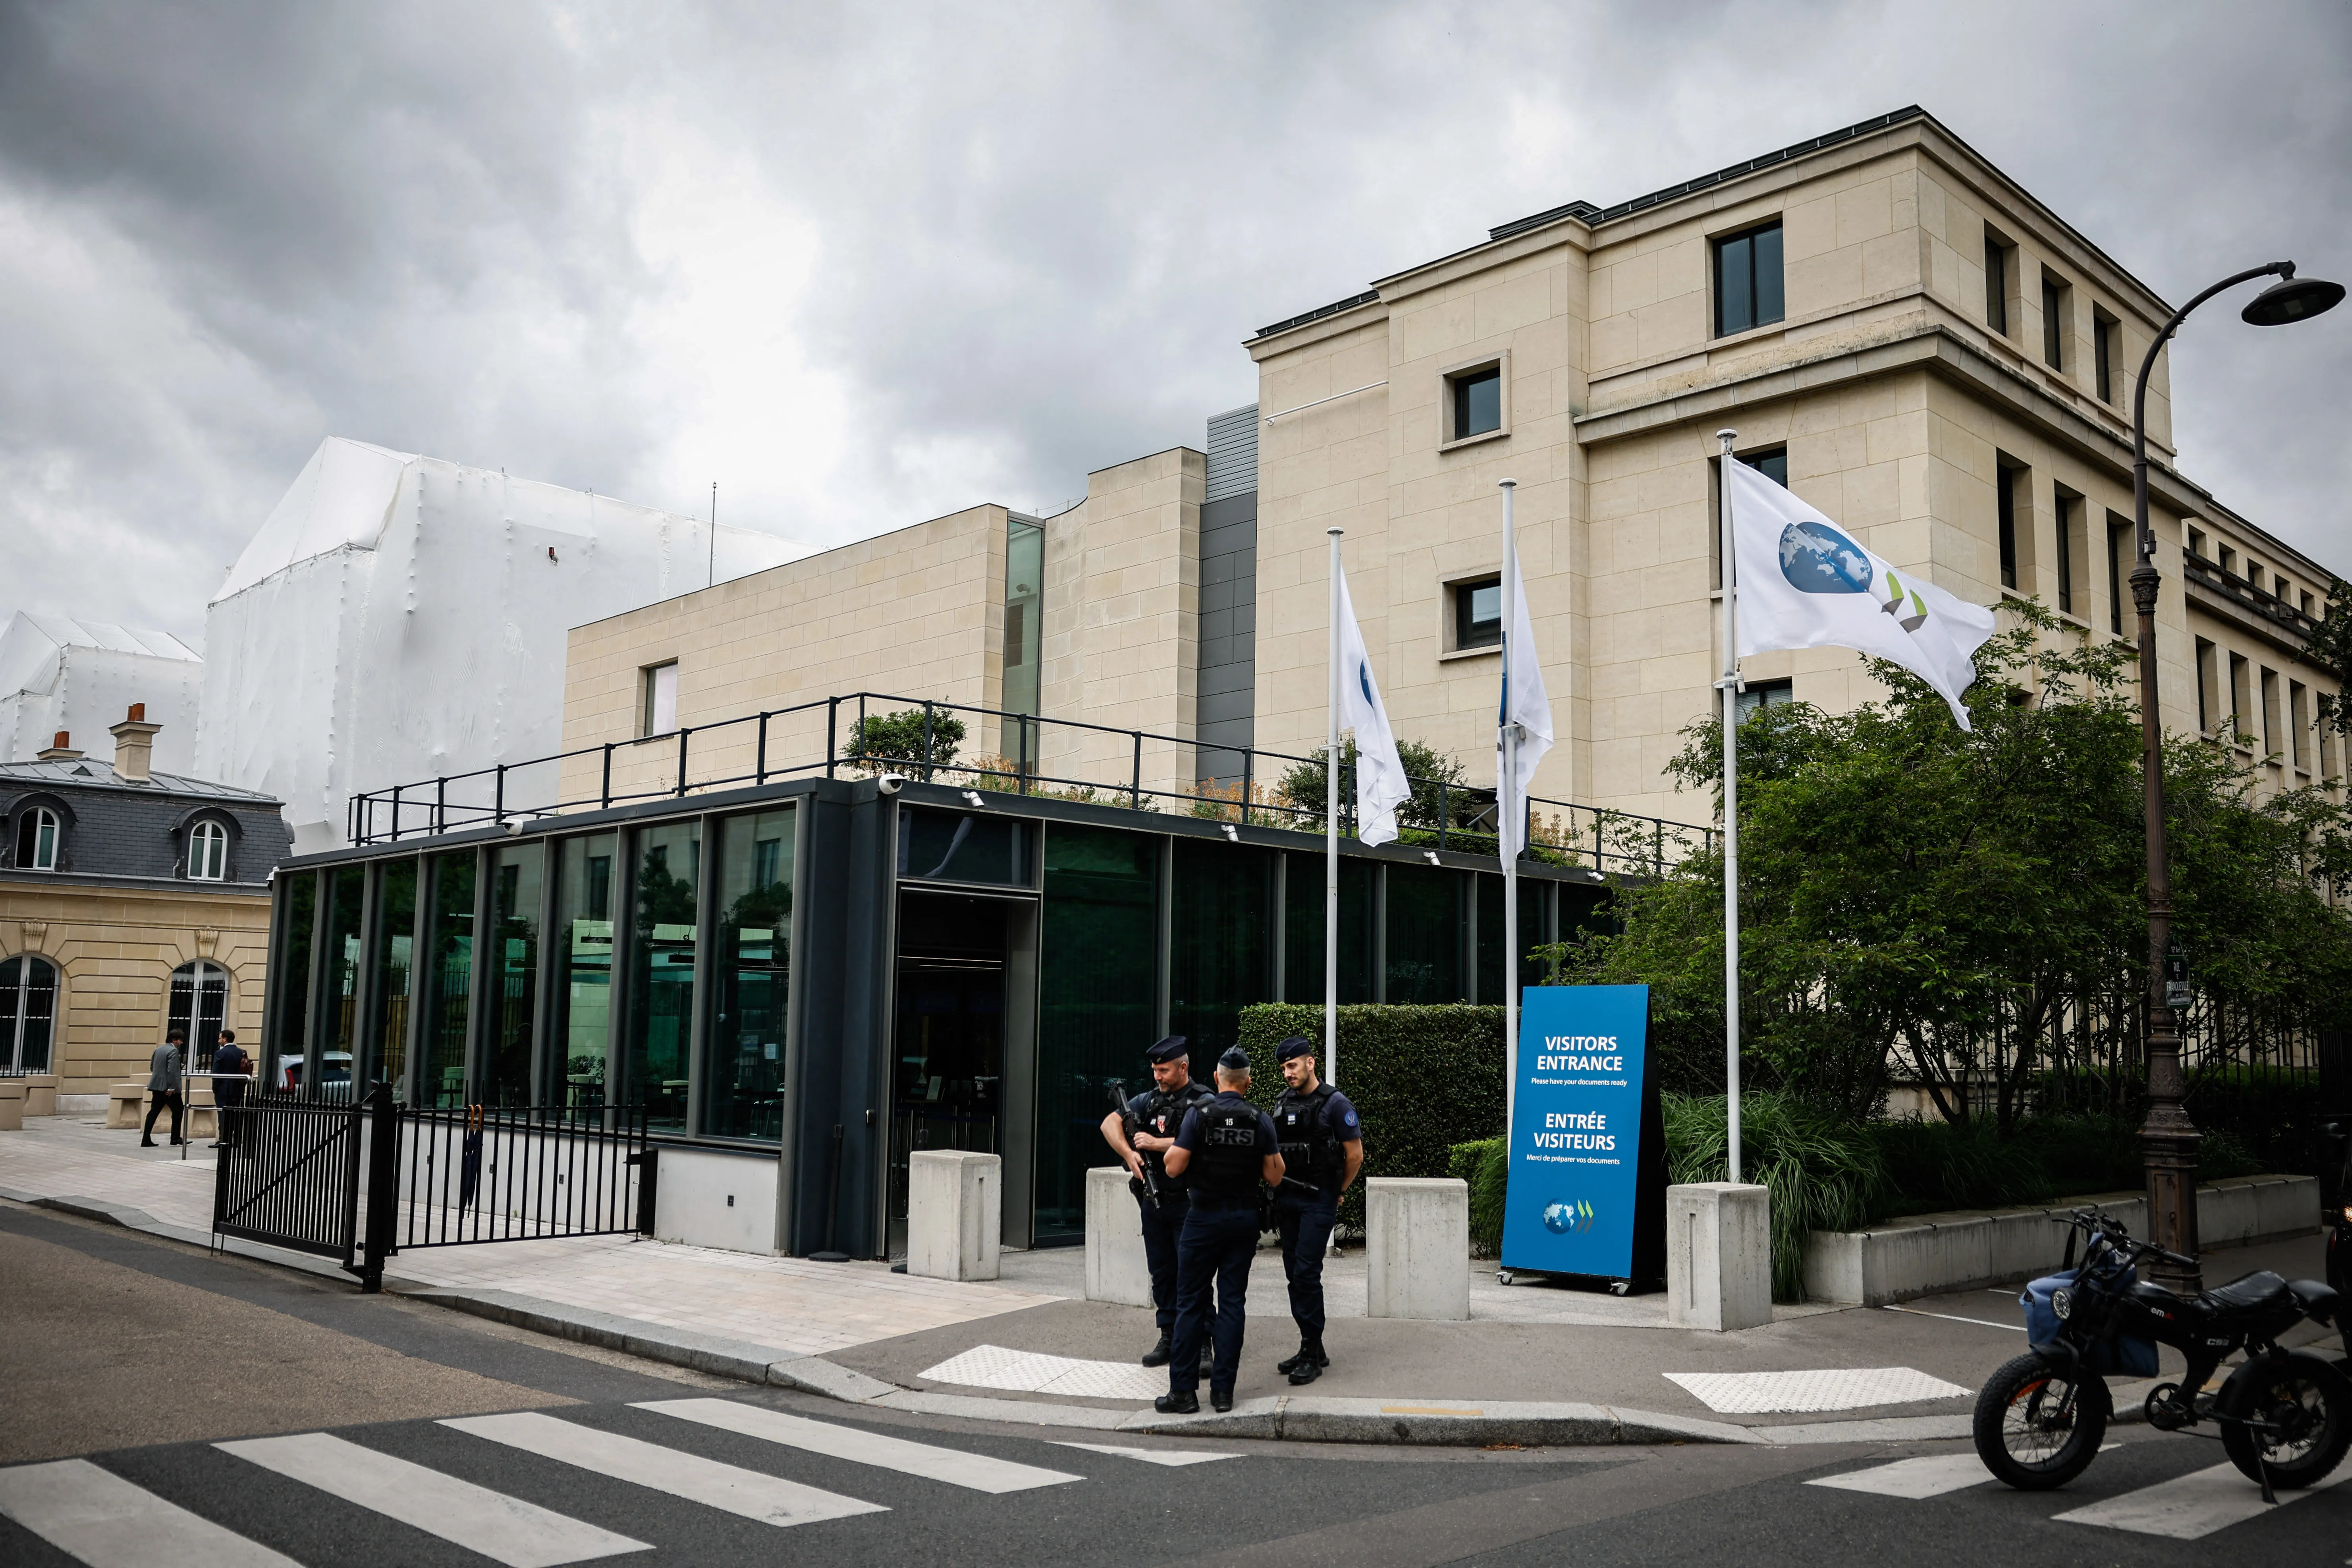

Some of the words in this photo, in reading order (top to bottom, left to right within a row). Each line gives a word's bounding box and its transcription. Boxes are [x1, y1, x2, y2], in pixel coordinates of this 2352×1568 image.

[2166, 981, 2189, 992] FRANQUEVILLE
[1545, 1036, 1617, 1051] VISITORS
[1537, 1055, 1623, 1071] ENTRANCE
[1545, 1111, 1606, 1130] ENTRÉE
[1208, 1129, 1252, 1145] CRS
[1534, 1132, 1615, 1151] VISITEURS
